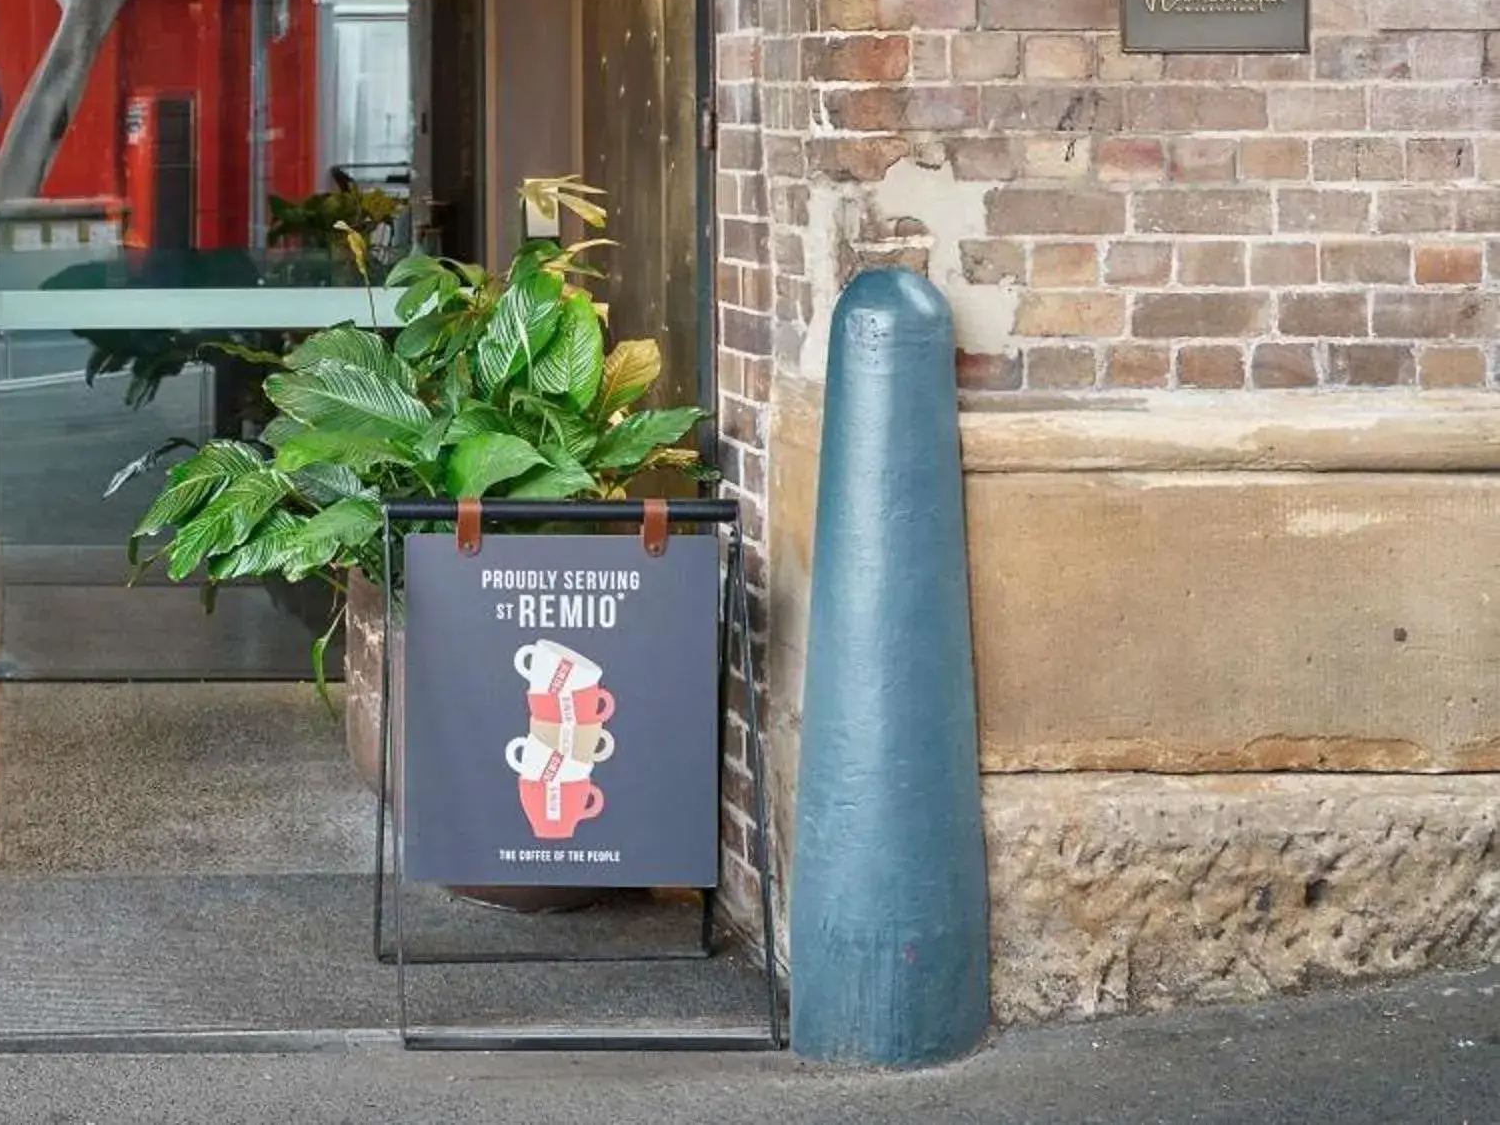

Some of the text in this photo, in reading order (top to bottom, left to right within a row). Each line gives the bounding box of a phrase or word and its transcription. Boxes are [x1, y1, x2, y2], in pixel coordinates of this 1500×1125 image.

[481, 569, 641, 591] PROUDLY SERVING
[496, 593, 617, 628] ST REMIO
[499, 849, 621, 863] THE COFFEE OF THE PEOPLE
